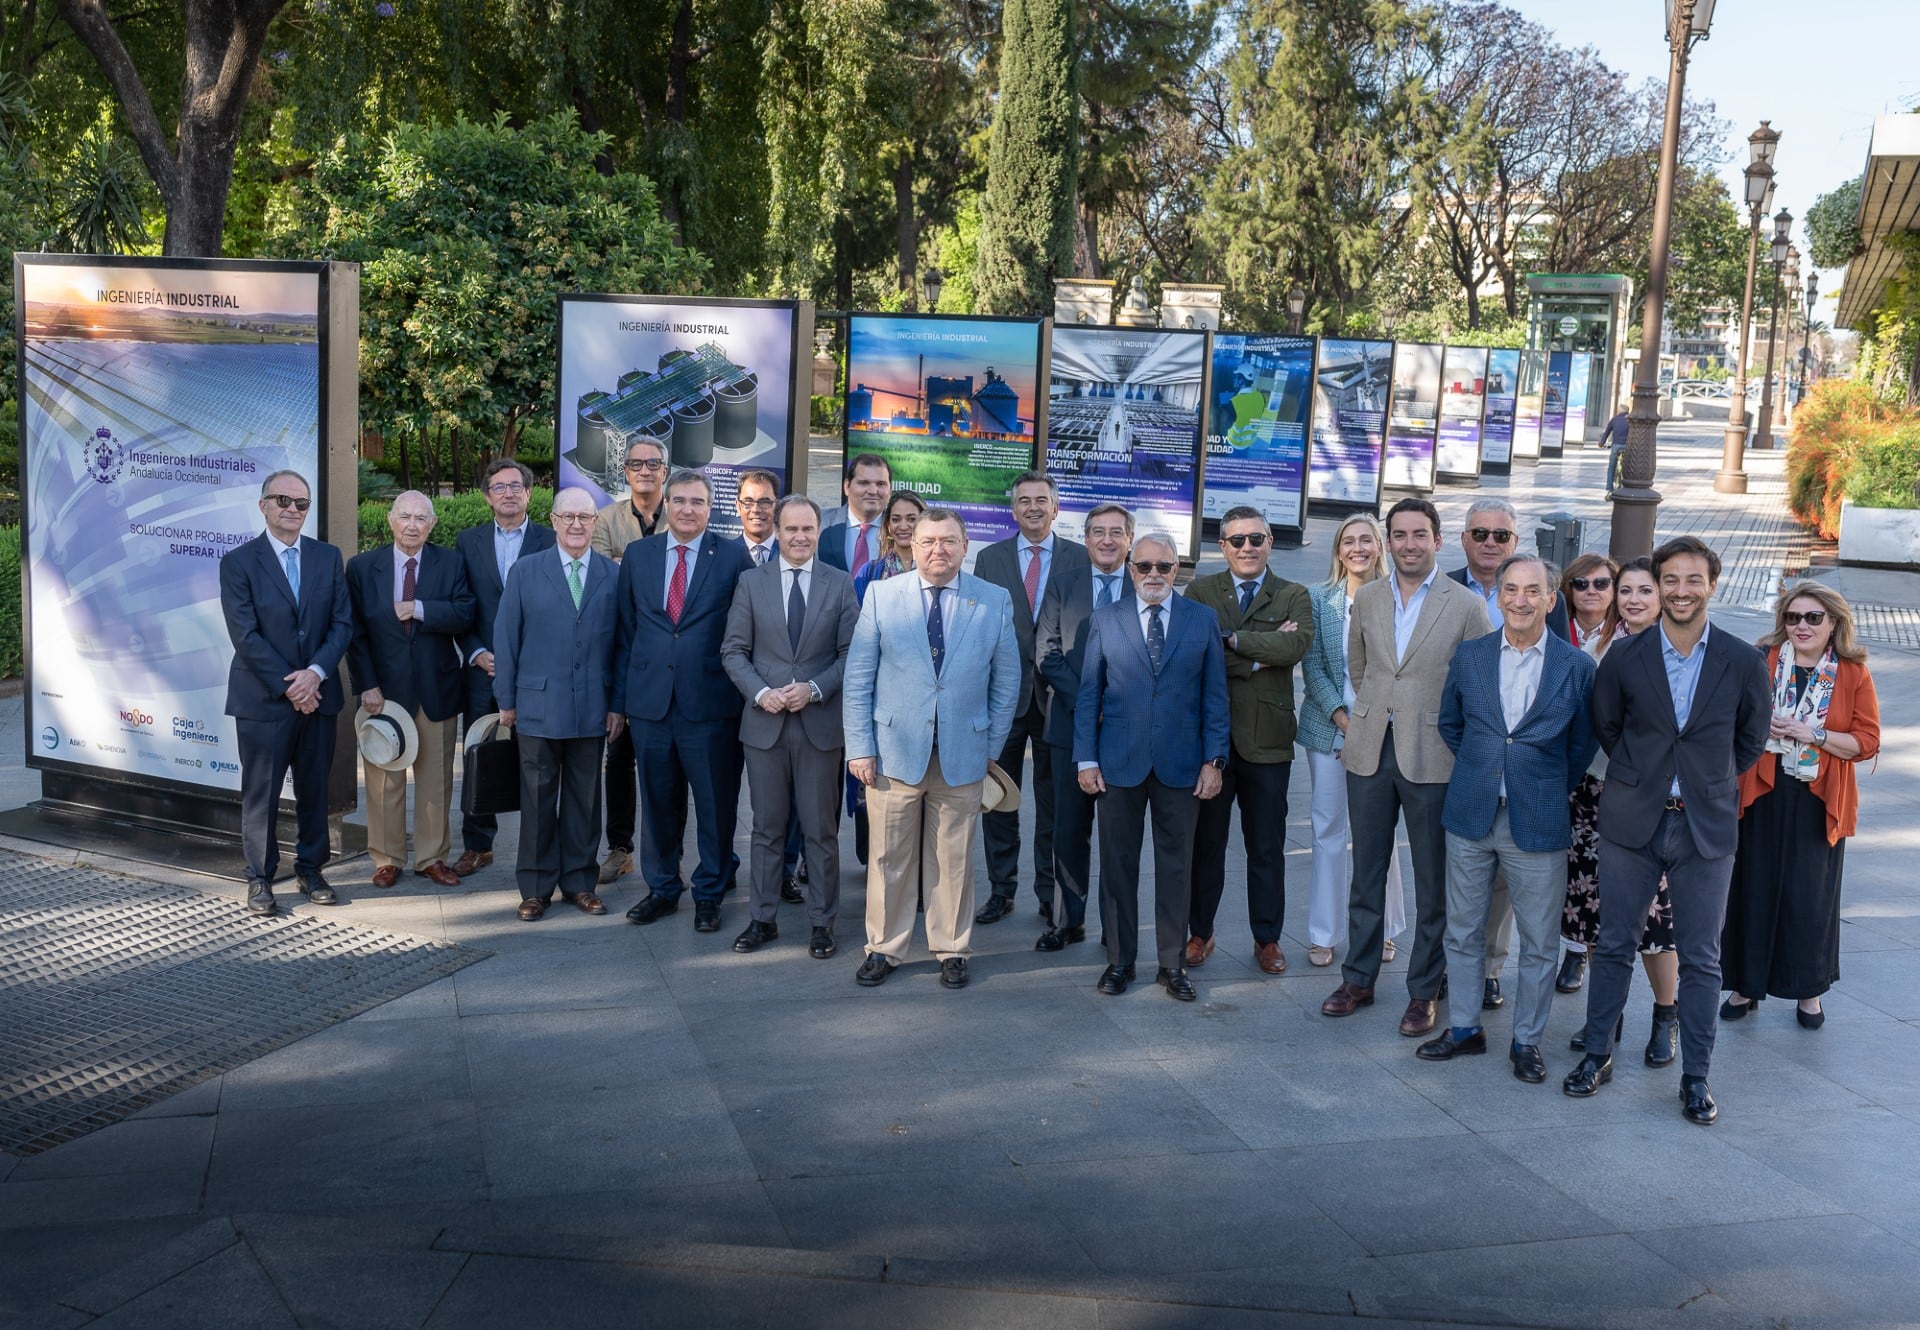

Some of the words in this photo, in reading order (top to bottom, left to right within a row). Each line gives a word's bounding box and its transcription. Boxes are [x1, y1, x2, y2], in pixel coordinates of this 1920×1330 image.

[97, 288, 163, 304] INGENIERÍA
[167, 293, 239, 308] INDUSTRIAL
[619, 320, 671, 333] INGENIERÍA
[673, 323, 729, 335] INDUSTRIAL
[897, 330, 940, 341] INGENIERÍA
[941, 333, 988, 343] INDUSTRIAL
[129, 449, 186, 466] Ingenieros
[190, 454, 256, 473] Industriales
[1046, 448, 1132, 463] TRANSFORMACIÓN
[130, 466, 172, 481] Andalucía
[175, 469, 221, 485] Occidental
[130, 524, 193, 540] SOLUCIONAR
[170, 544, 214, 558] SUPERAR
[172, 717, 194, 730] Caja
[173, 727, 219, 743] Ingenieros
